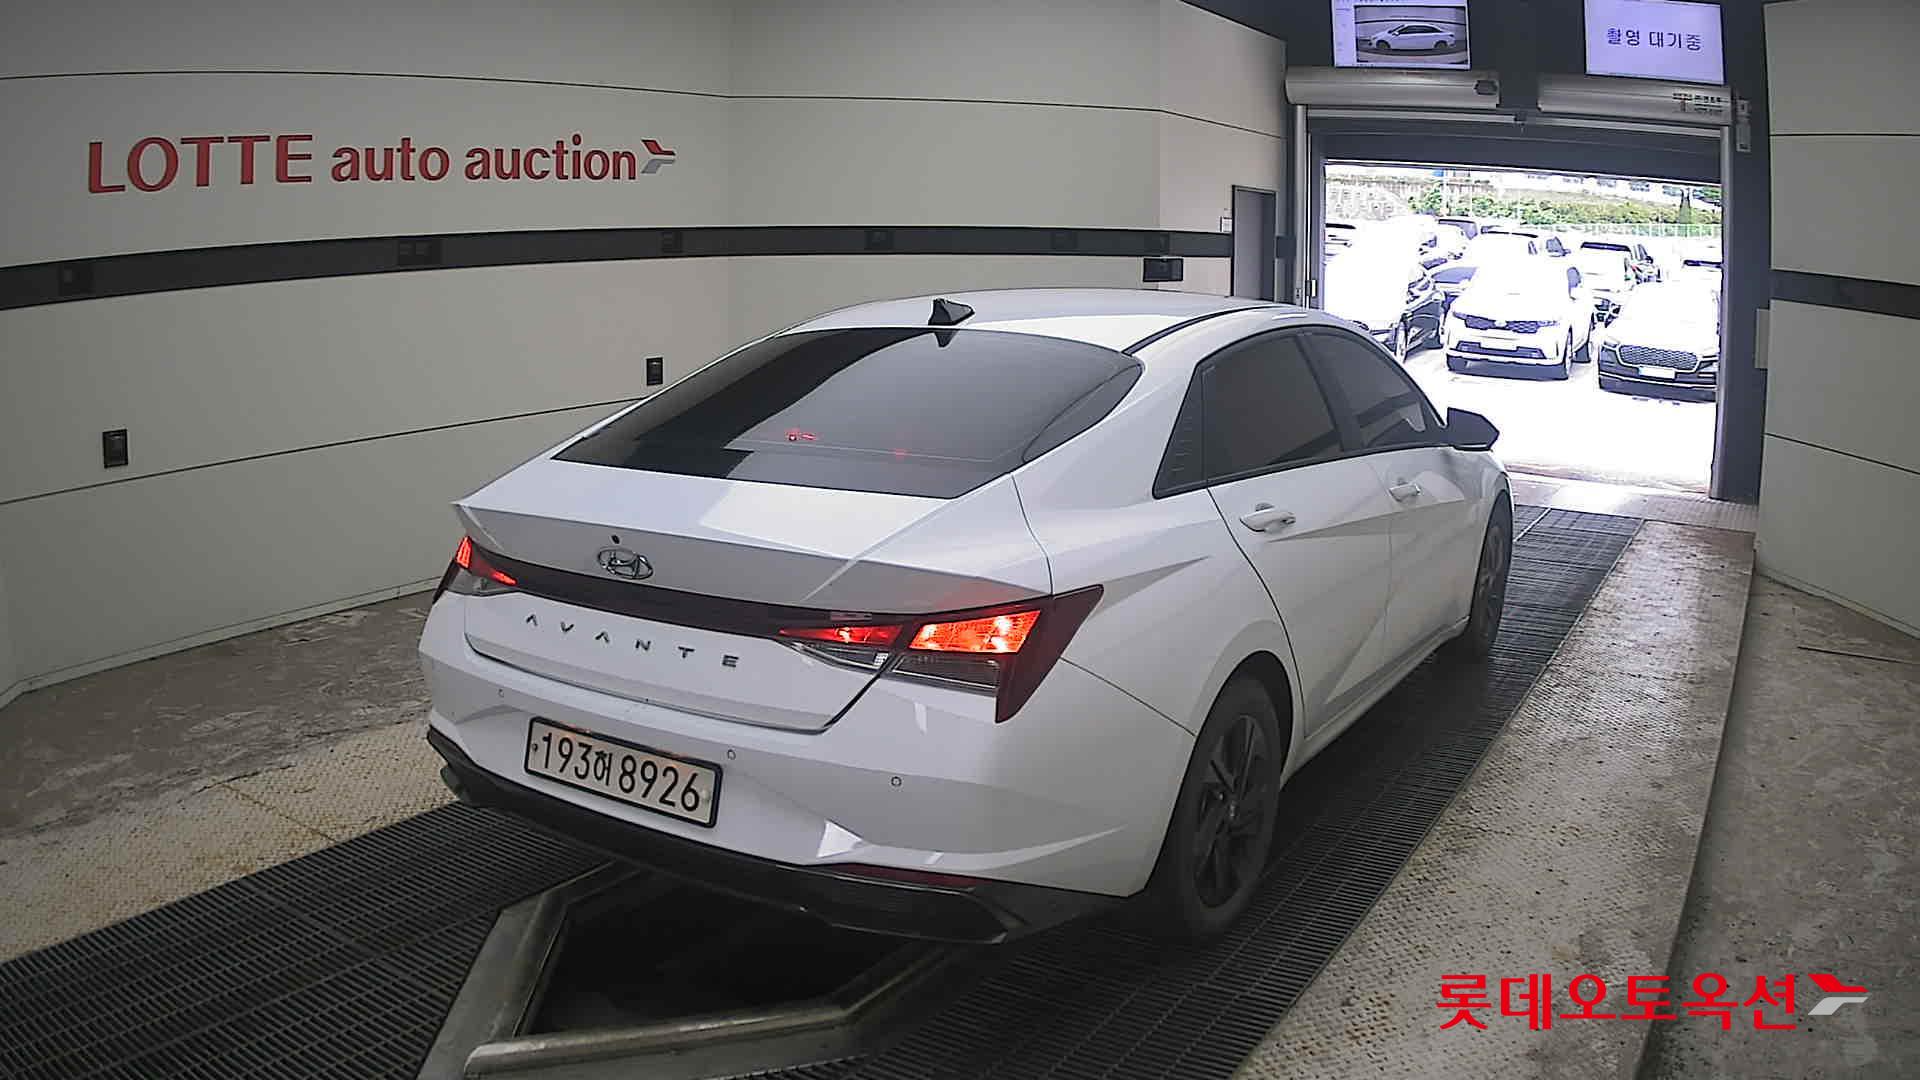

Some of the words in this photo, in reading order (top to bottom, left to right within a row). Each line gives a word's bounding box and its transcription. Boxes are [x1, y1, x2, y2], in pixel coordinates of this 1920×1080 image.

[1649, 31, 1702, 51] 대기중
[88, 134, 313, 194] LOTTE
[331, 137, 450, 182] auto
[464, 133, 637, 181] auction
[525, 613, 740, 668] AVANTE
